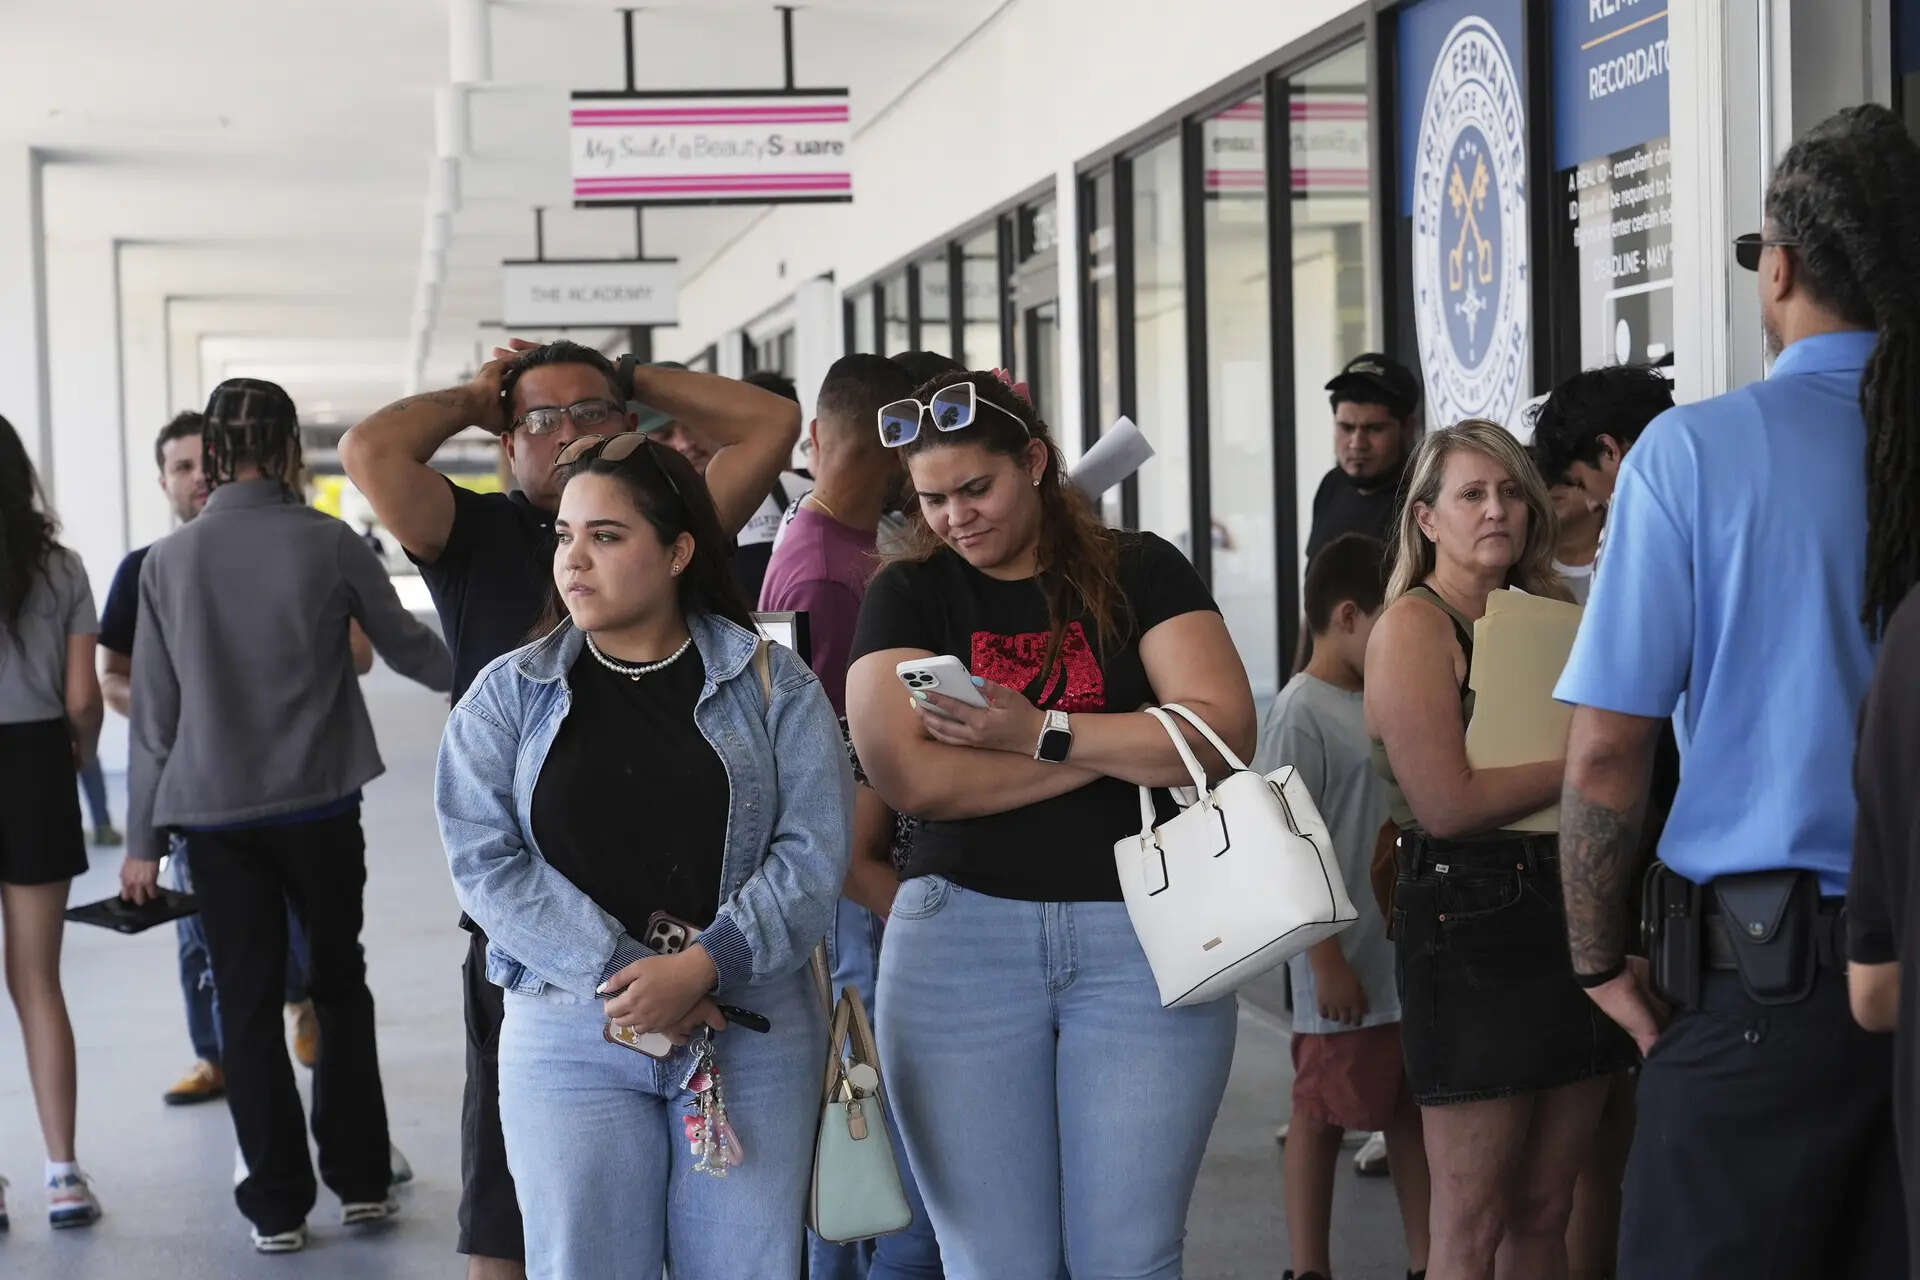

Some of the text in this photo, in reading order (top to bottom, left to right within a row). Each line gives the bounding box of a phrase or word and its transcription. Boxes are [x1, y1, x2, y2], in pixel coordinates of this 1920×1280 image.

[1568, 172, 1577, 192] A
[1614, 149, 1655, 179] compliant
[1621, 177, 1655, 208] required
[1656, 179, 1664, 196] to
[1612, 217, 1632, 238] enter
[1632, 207, 1659, 232] certain
[1647, 243, 1669, 270] MAY
